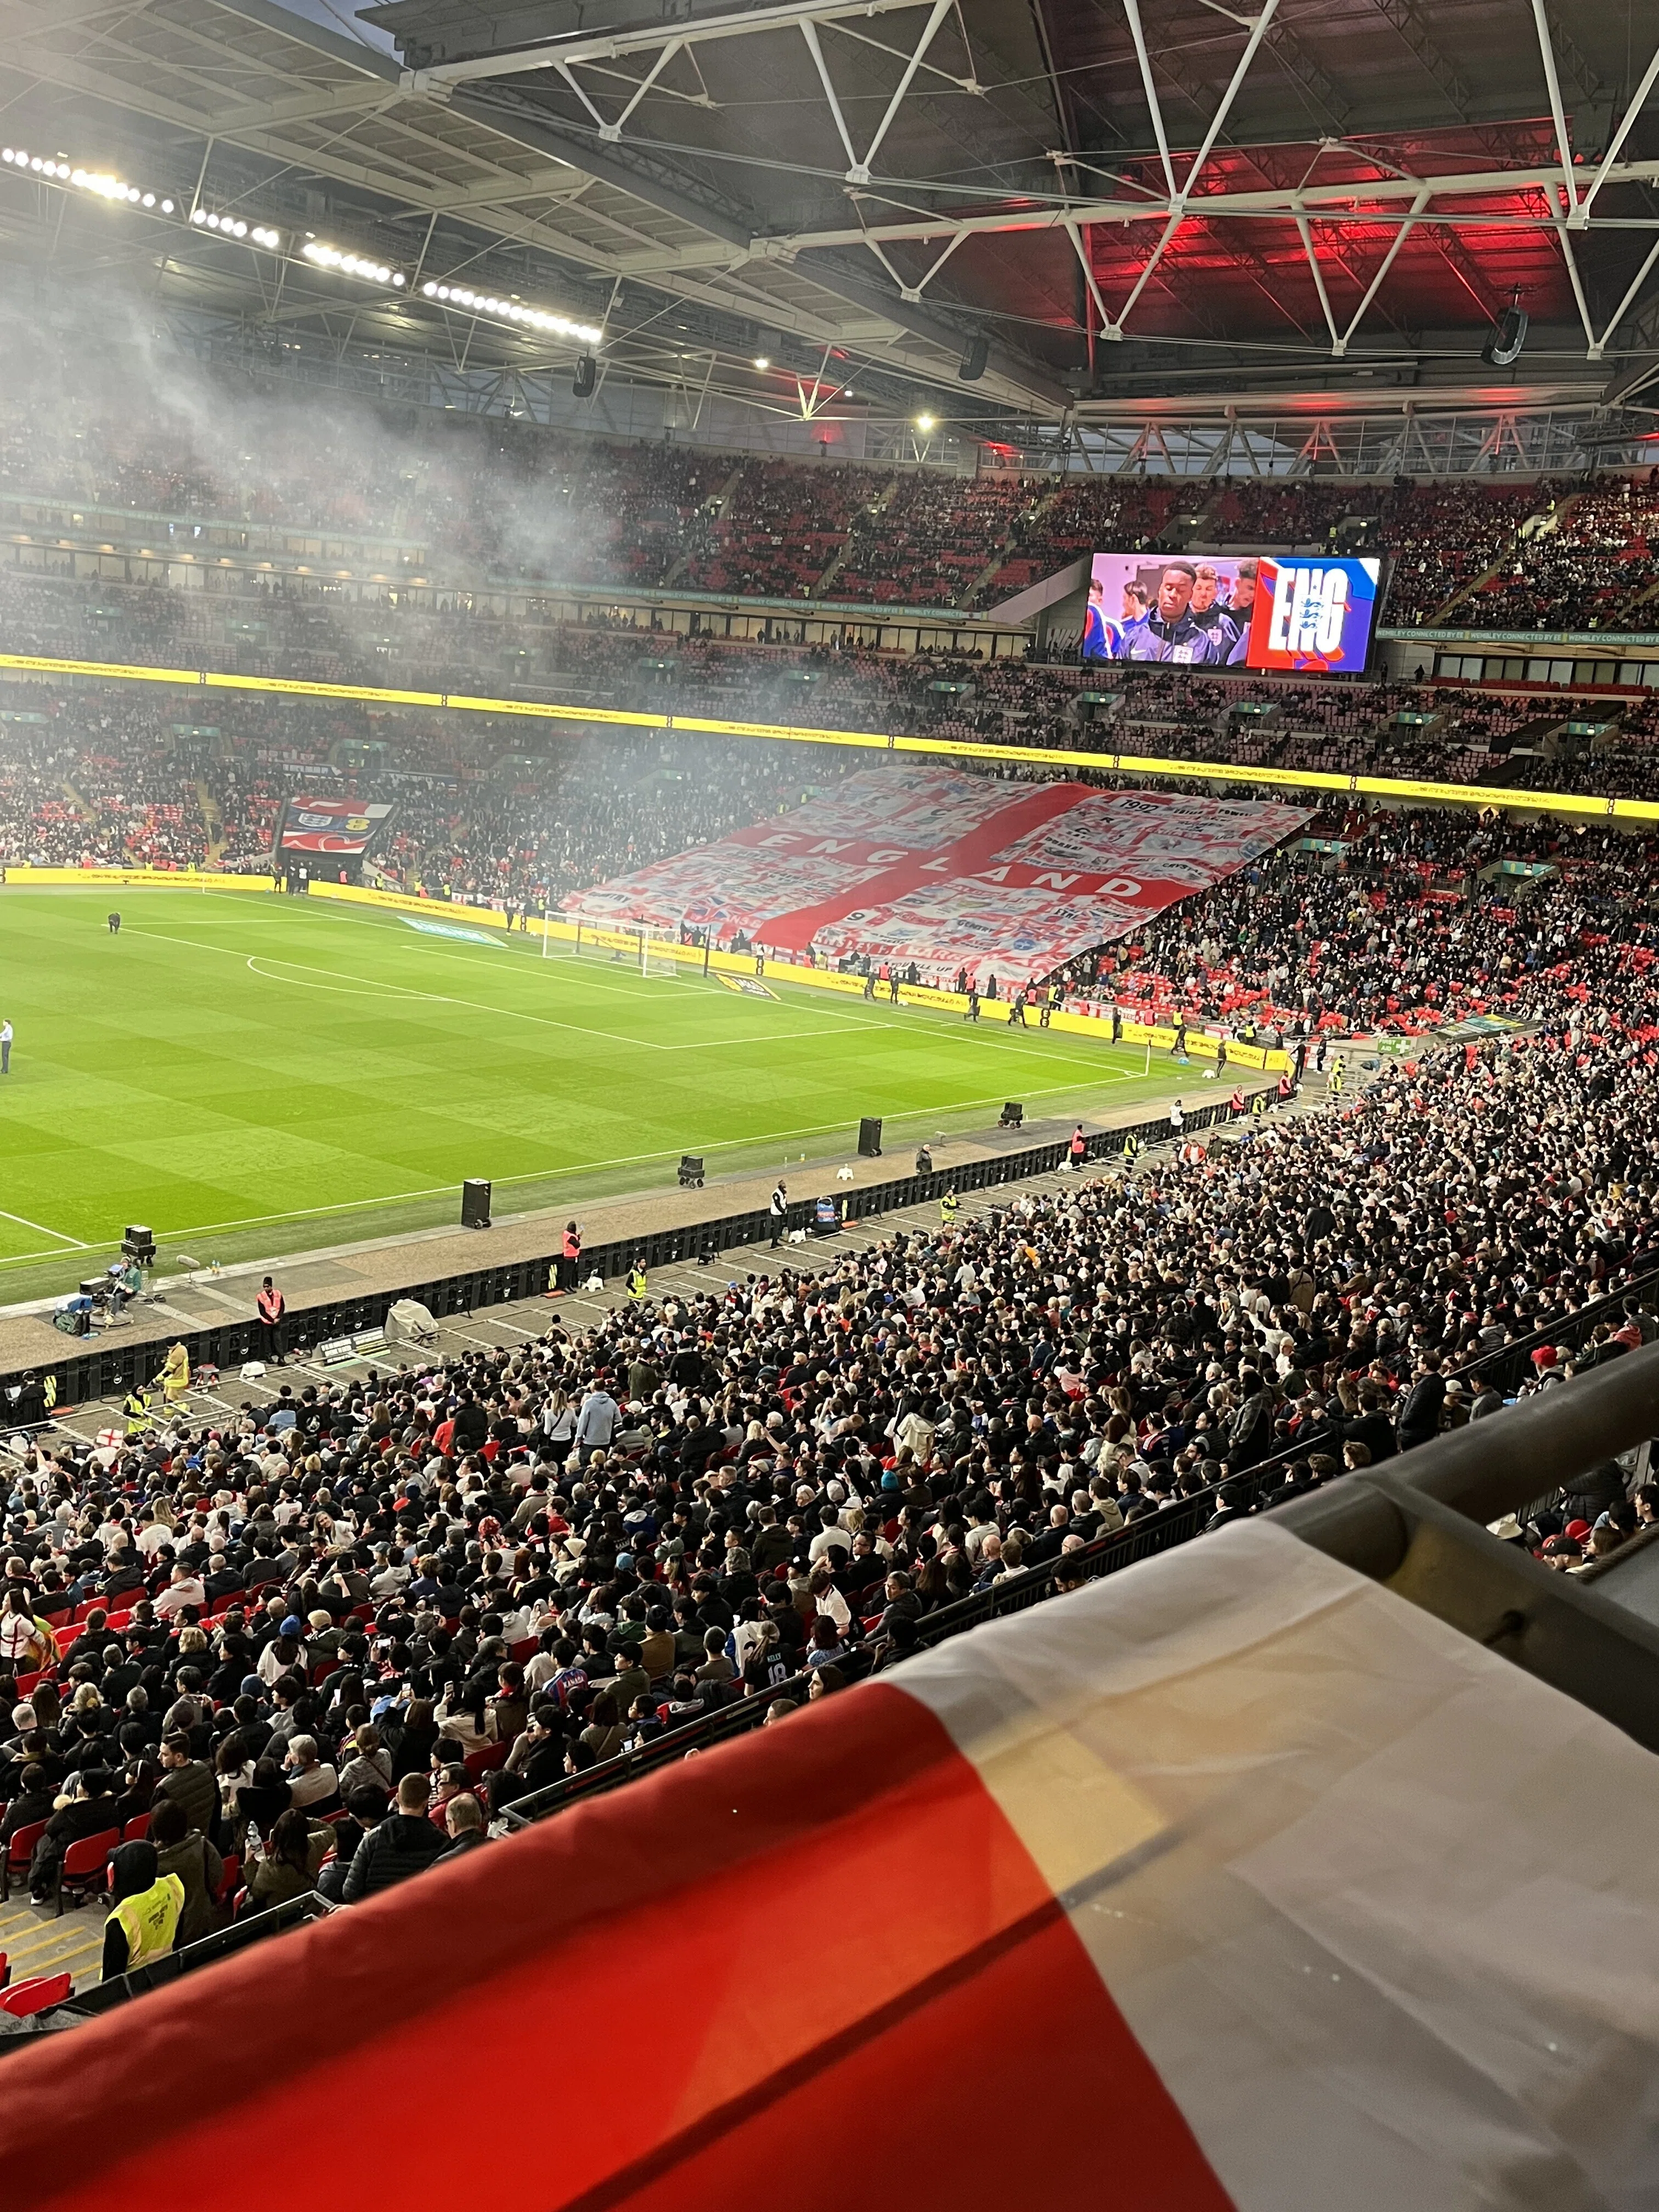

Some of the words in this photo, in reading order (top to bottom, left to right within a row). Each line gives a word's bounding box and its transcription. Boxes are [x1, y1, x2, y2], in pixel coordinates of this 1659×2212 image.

[1267, 568, 1348, 653] ENG
[1119, 799, 1159, 814] 1992
[757, 833, 1142, 897] ENGLAND
[1163, 863, 1204, 877] CRYSTAL
[768, 1662, 787, 1685] 18
